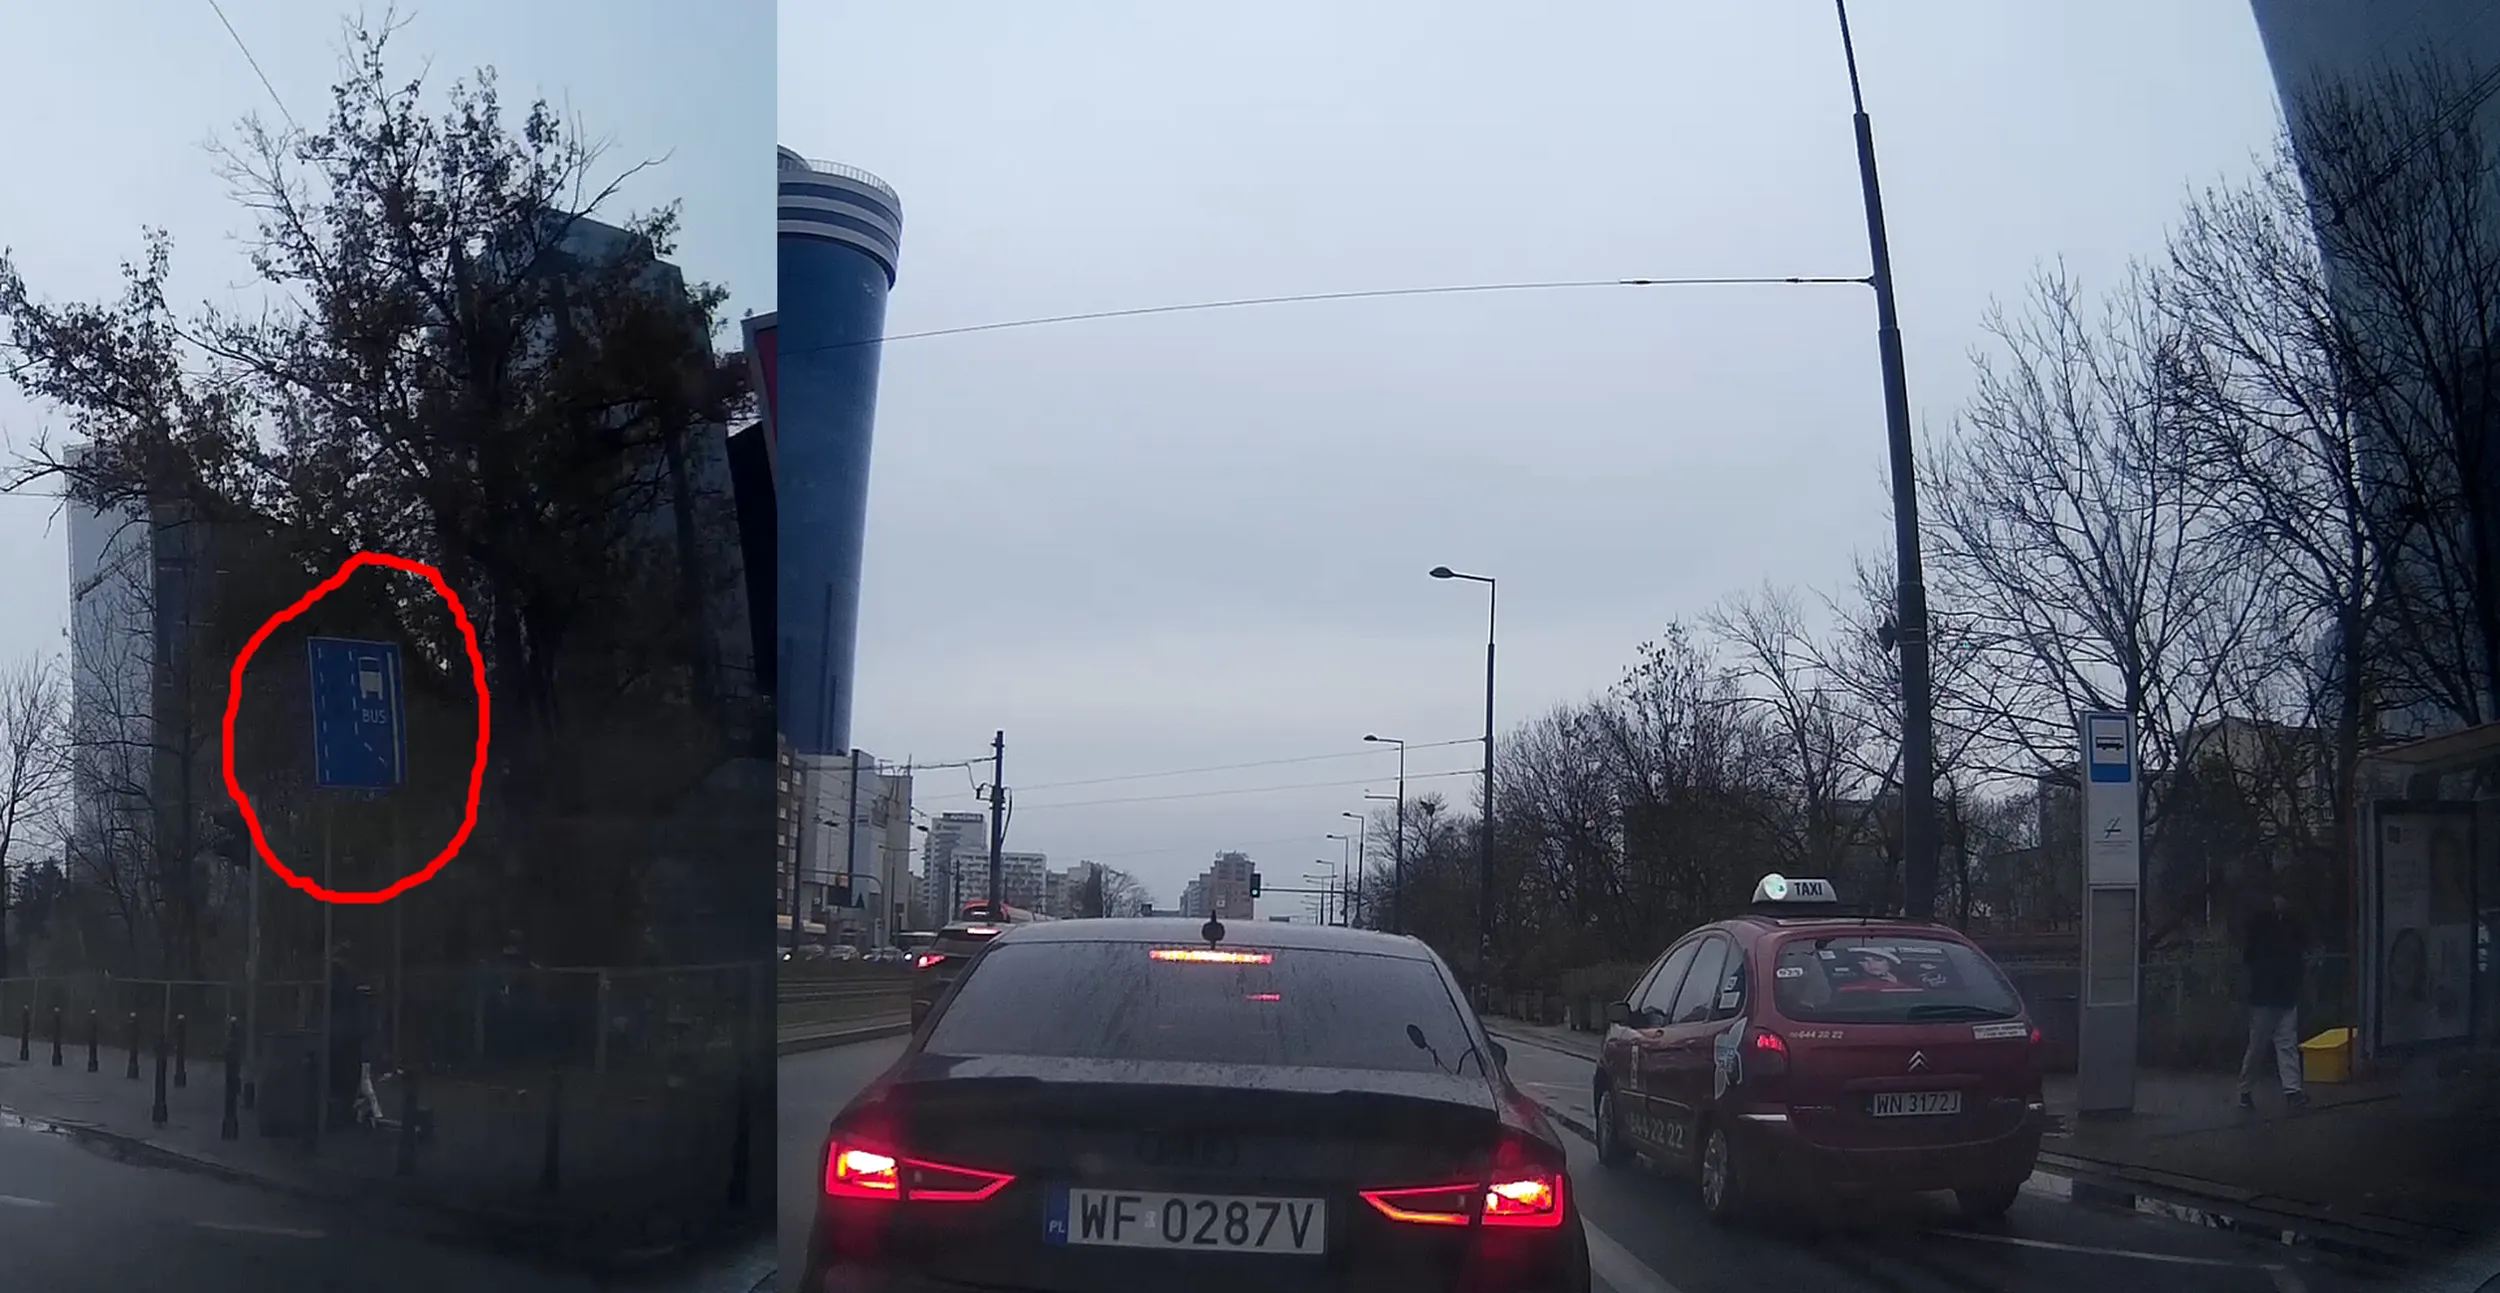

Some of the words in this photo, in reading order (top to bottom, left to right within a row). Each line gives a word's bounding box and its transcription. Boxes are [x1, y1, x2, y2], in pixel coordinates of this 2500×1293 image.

[362, 708, 387, 724] BUS
[1794, 882, 1823, 896] TAXI
[1876, 1095, 1900, 1113] WN
[1907, 1093, 1957, 1112] 3172J
[1666, 1122, 1684, 1149] 22
[1048, 1219, 1066, 1233] PL
[1081, 1193, 1142, 1241] WF
[1161, 1198, 1314, 1249] 0287V
